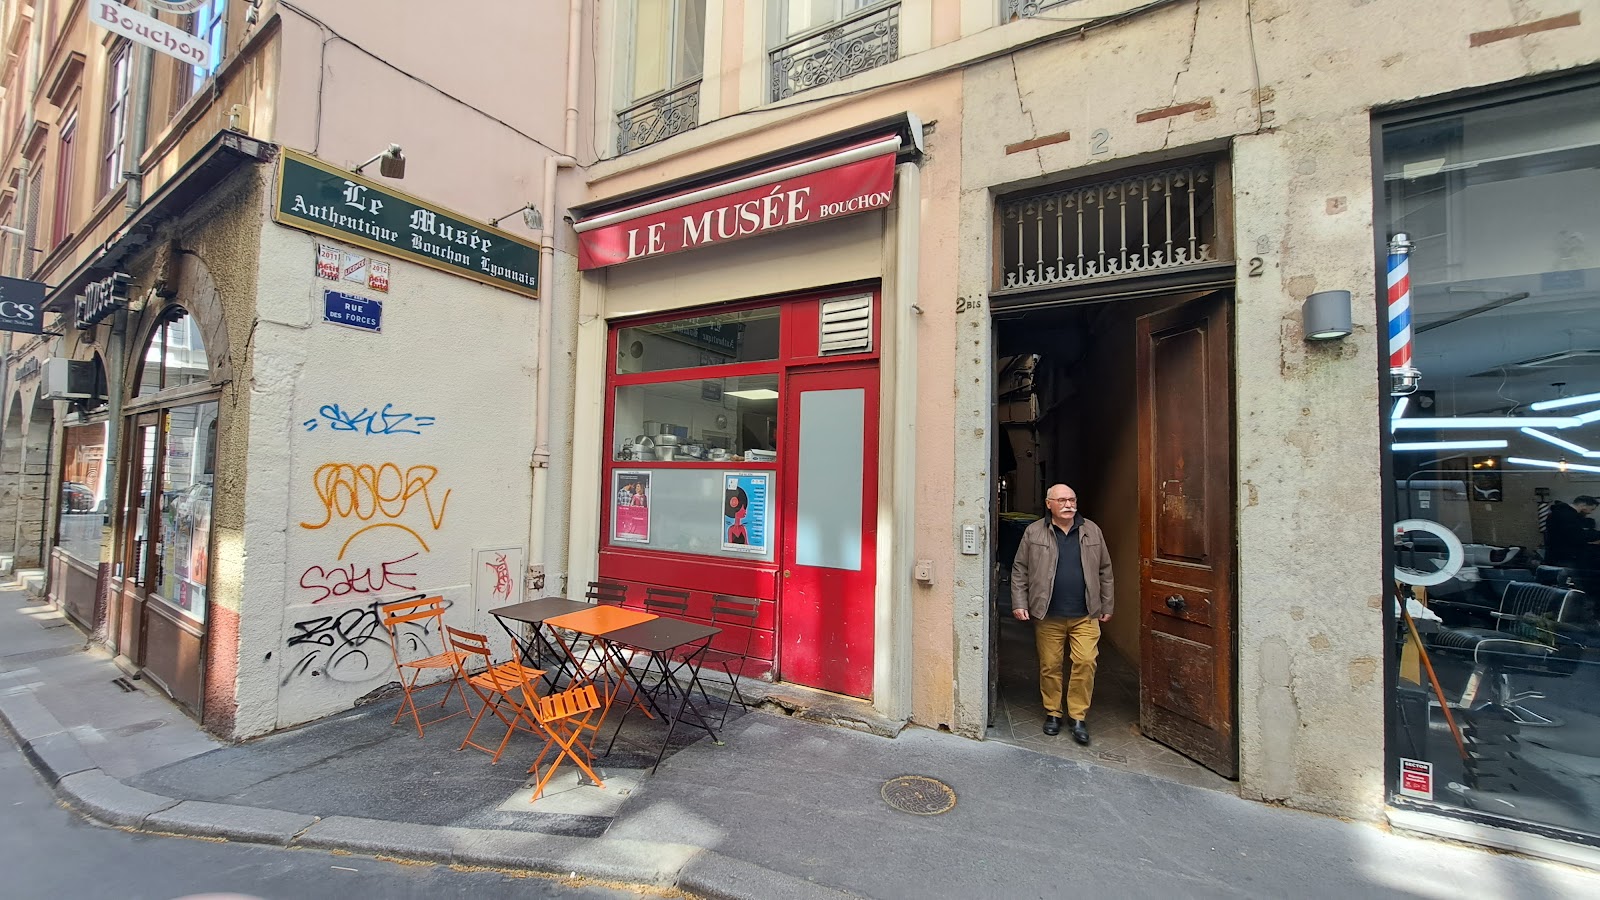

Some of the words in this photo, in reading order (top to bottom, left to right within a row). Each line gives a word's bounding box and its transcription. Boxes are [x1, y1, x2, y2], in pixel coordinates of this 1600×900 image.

[100, 4, 205, 62] Bouchon
[1091, 128, 1109, 155] 2
[343, 181, 384, 215] Le
[408, 209, 492, 253] Musée
[627, 222, 666, 260] LE
[681, 185, 810, 248] MUSÉE
[820, 190, 892, 218] BOUCHON
[291, 195, 399, 243] Authentique
[411, 233, 470, 266] Bouchon
[480, 256, 535, 286] Lyonnais
[321, 251, 338, 261] 2011
[344, 258, 366, 276] LICENCE
[372, 265, 387, 274] 2012
[1249, 257, 1264, 278] 2
[344, 303, 363, 313] RUE
[955, 296, 966, 314] 2
[966, 301, 981, 309] BIS
[330, 311, 342, 319] DES
[346, 313, 376, 326] FORCES
